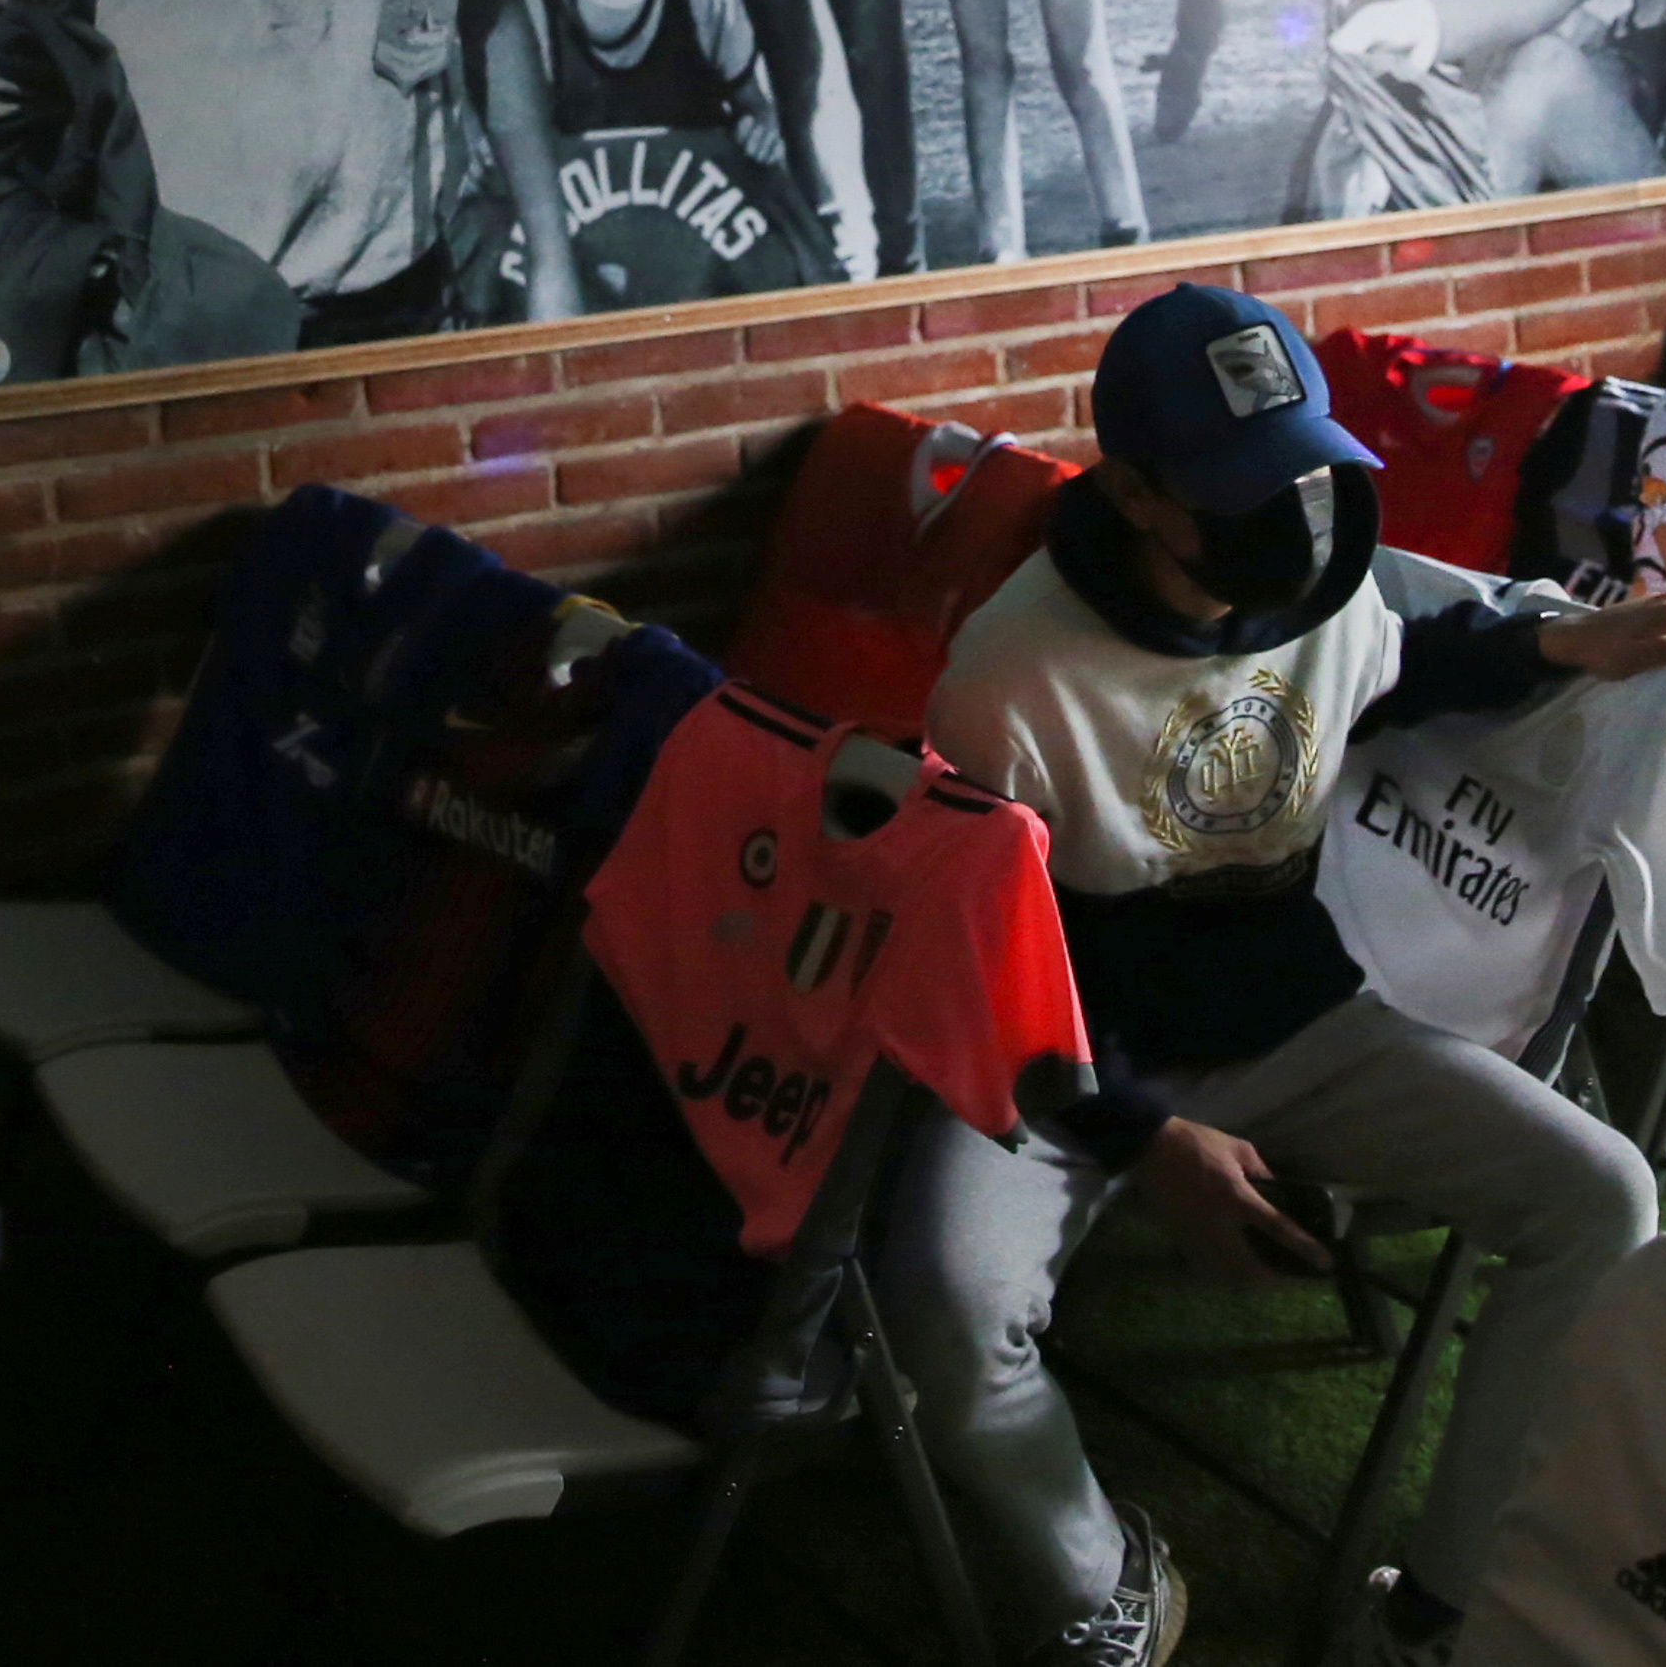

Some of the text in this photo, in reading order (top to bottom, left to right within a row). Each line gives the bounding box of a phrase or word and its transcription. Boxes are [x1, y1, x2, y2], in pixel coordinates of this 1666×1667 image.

[1355, 770, 1530, 926] Emirates
[1444, 774, 1515, 846] Fly
[678, 1022, 832, 1166] Jeep
